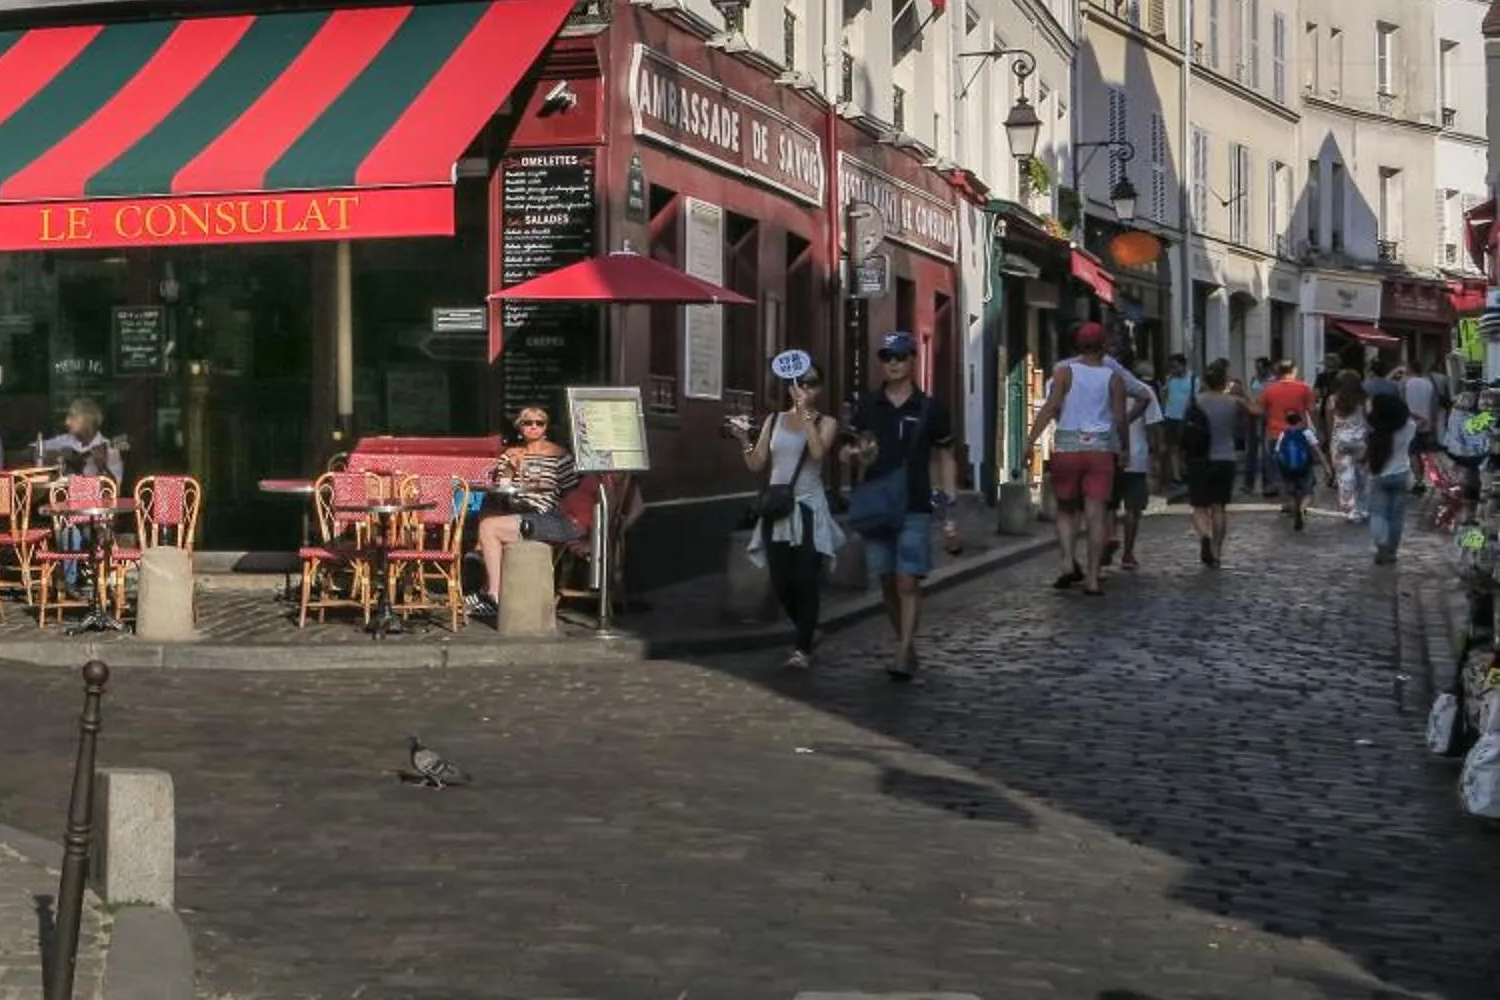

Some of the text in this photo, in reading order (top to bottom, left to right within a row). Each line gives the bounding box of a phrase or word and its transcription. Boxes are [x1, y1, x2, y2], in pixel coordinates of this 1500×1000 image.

[639, 69, 820, 189] AMBASSADE DE SAVOIE
[521, 155, 578, 167] OMELETTES
[39, 207, 92, 242] LE
[114, 195, 359, 239] CONSULAT
[524, 213, 569, 225] SALADES
